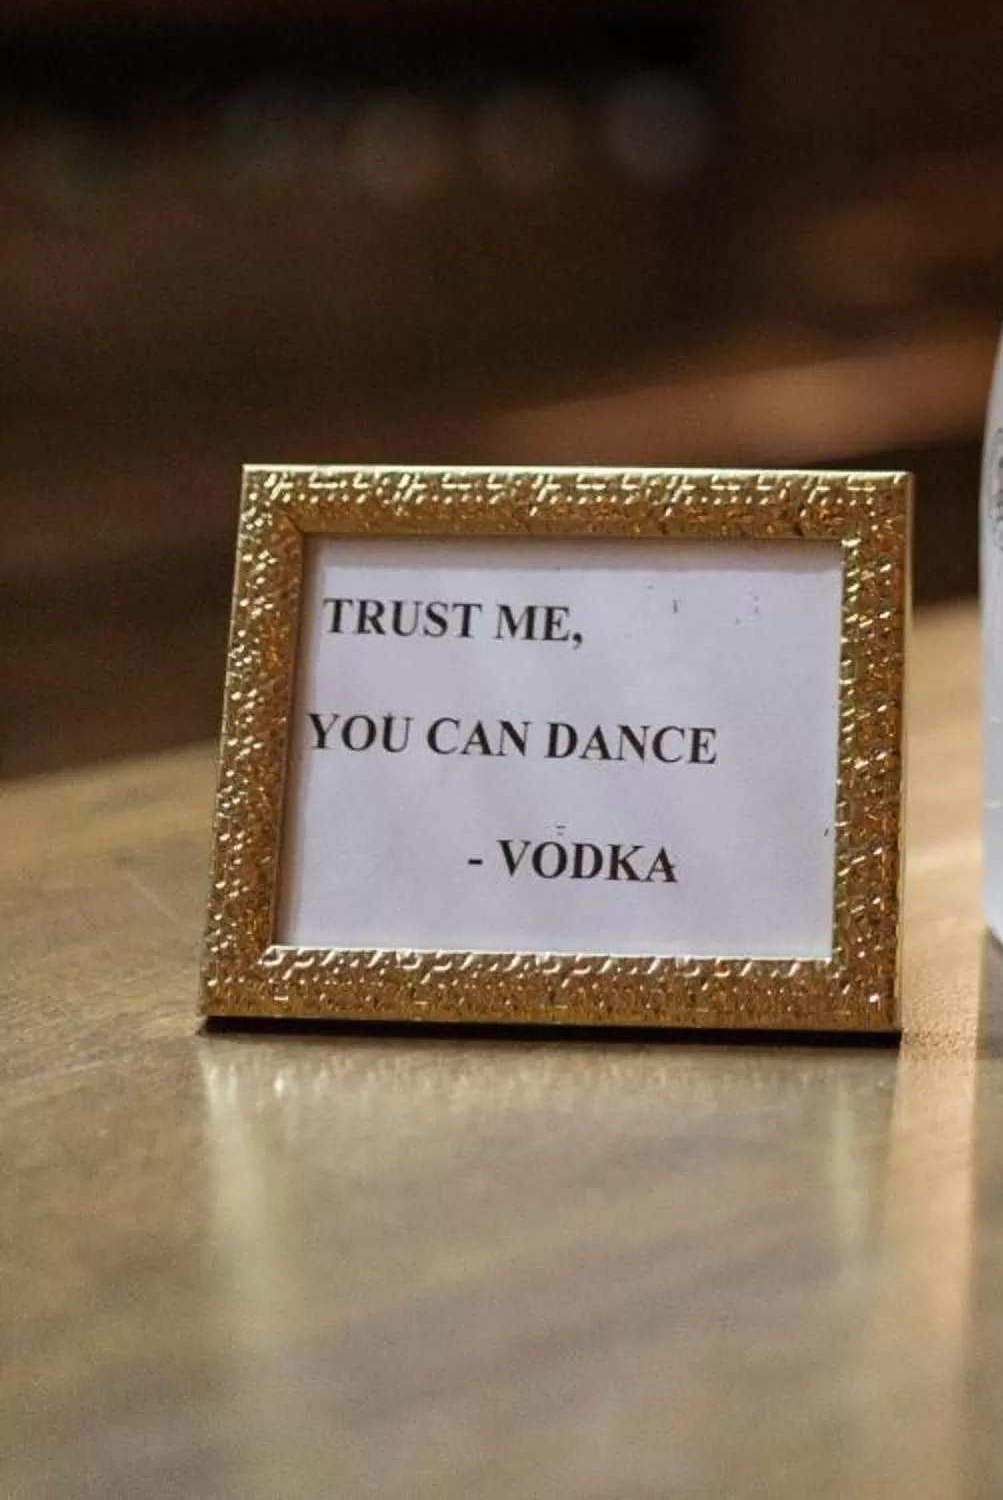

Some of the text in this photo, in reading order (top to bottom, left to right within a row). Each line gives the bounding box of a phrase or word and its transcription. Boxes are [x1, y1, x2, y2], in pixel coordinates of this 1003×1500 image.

[323, 597, 584, 650] TRUST ME,
[307, 712, 717, 766] YOU CAN DANCE
